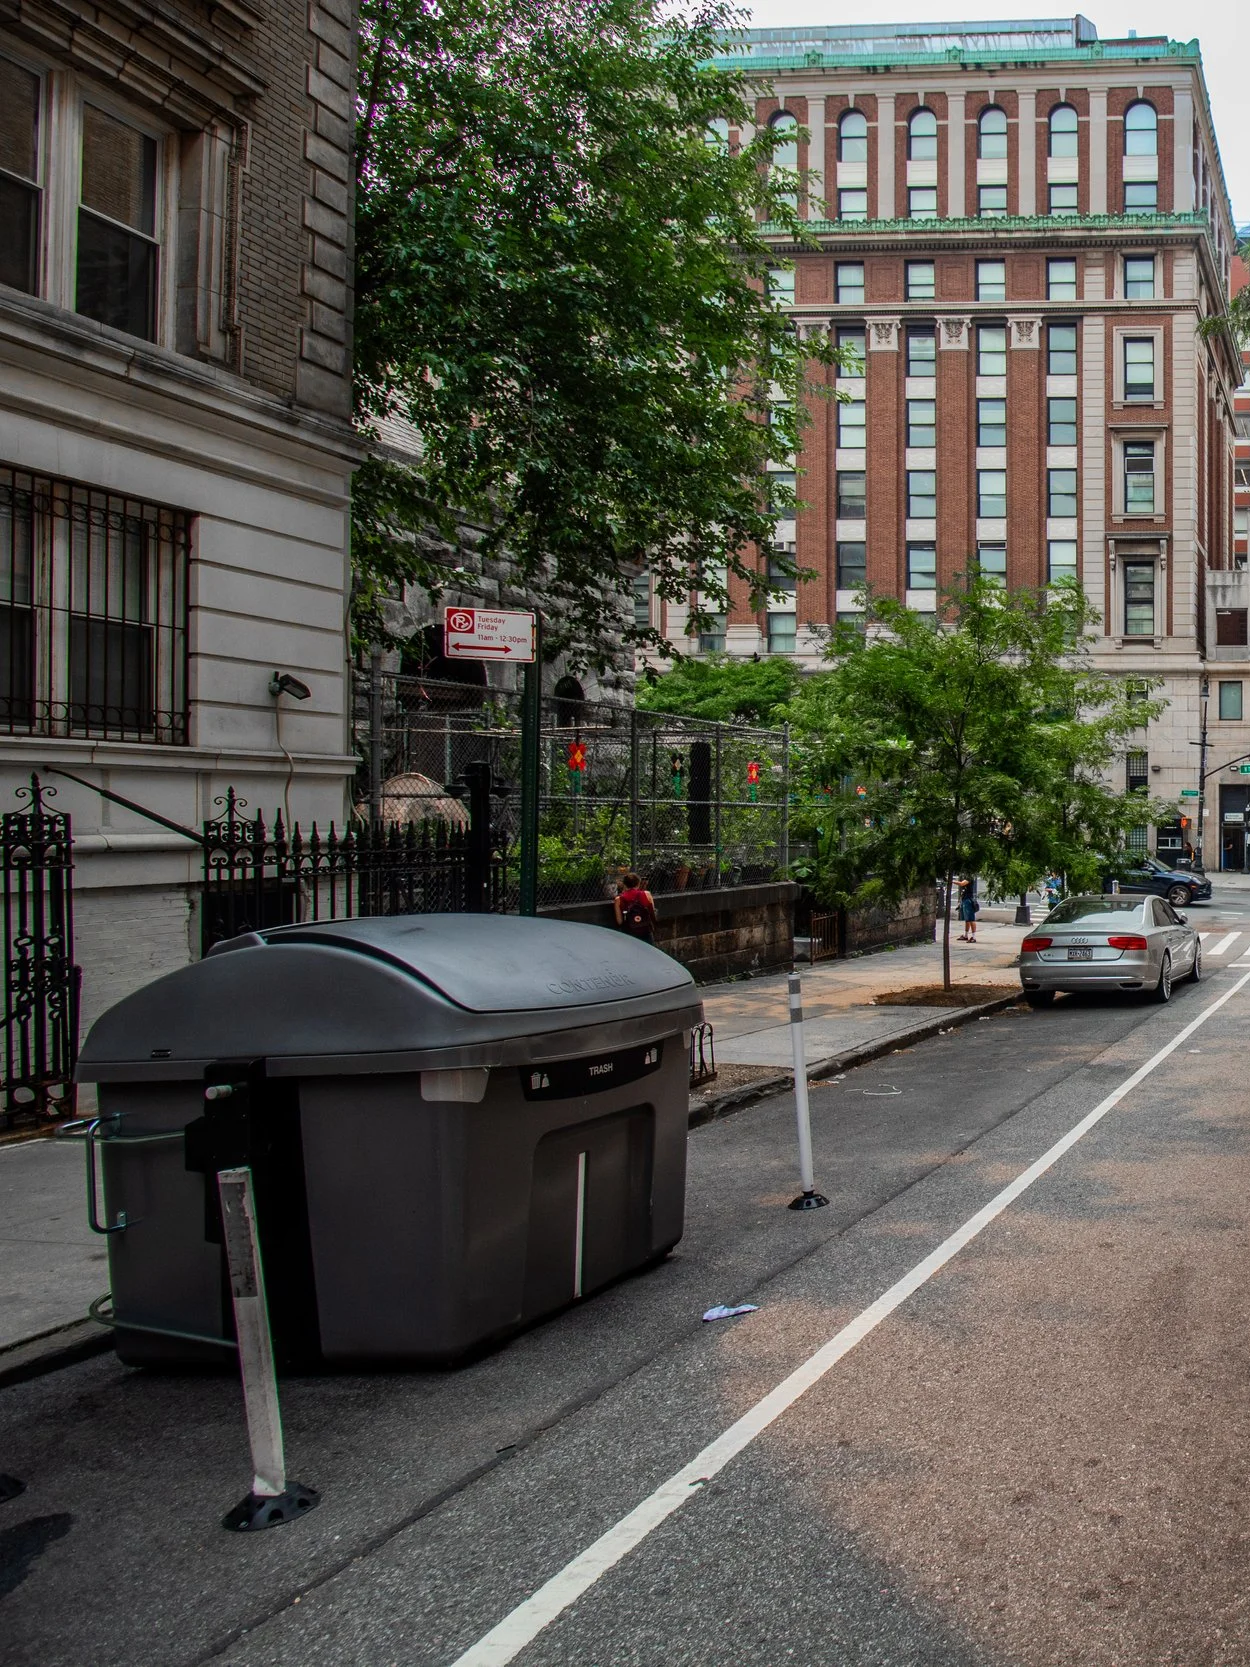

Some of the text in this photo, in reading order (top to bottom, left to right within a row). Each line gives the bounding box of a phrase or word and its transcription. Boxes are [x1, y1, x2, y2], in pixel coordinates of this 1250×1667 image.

[477, 616, 506, 625] Tuesday
[477, 623, 499, 632] Friday
[588, 1062, 613, 1076] TRASH
